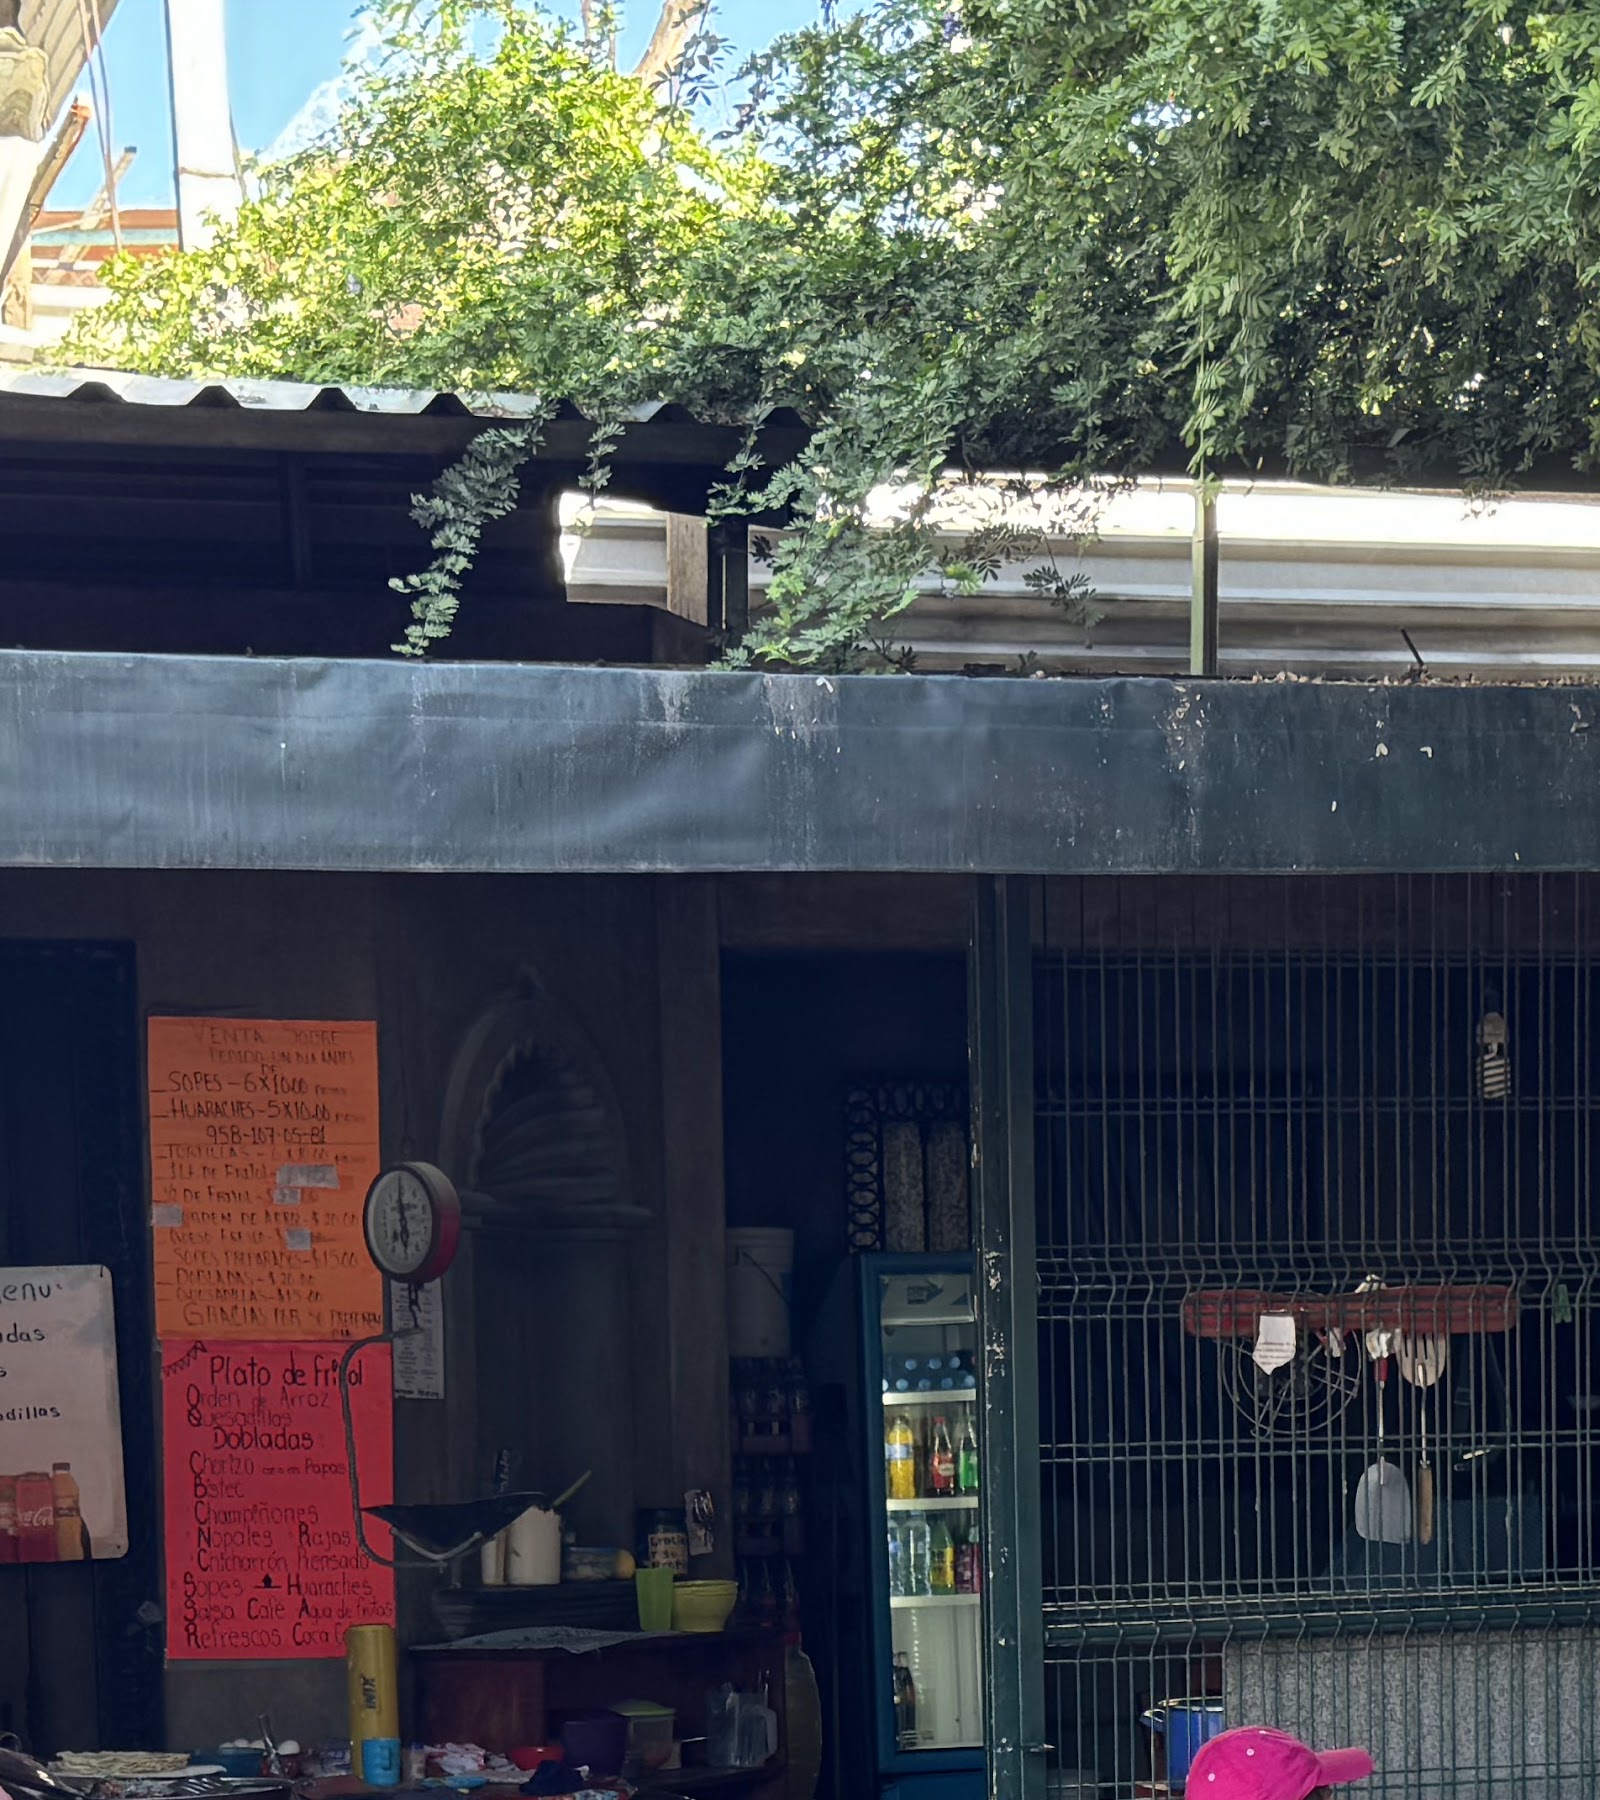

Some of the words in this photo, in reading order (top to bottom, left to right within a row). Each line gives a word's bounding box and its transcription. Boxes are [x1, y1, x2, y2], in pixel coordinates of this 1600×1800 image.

[167, 1070, 223, 1094] SOPES
[210, 1355, 272, 1387] Plato
[282, 1350, 307, 1387] de
[186, 1383, 241, 1408] Orden
[197, 1526, 273, 1550] Nopales
[299, 1521, 351, 1551] Rajas
[183, 1571, 244, 1600] Sopes
[184, 1622, 282, 1649] Refrescos
